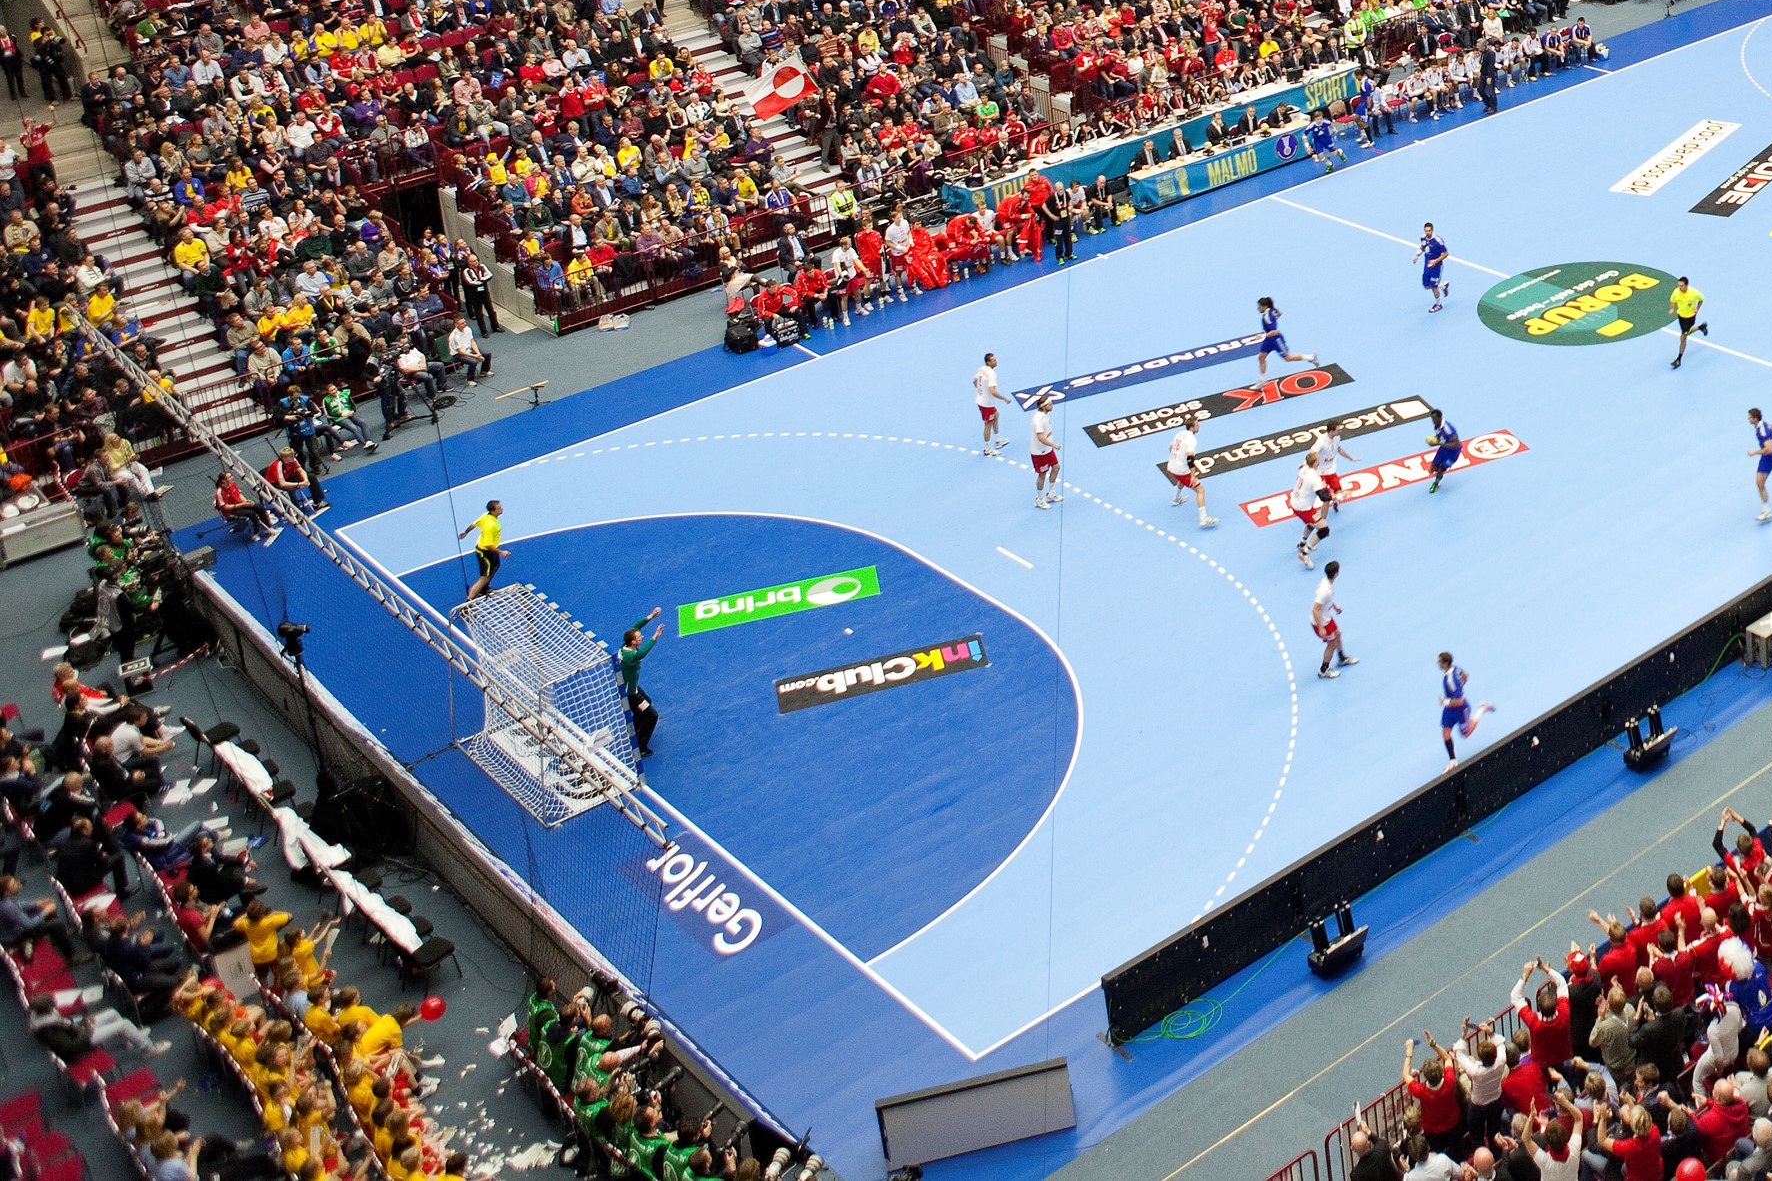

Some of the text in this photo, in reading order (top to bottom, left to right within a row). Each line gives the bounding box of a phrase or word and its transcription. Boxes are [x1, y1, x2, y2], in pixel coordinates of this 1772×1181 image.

[1304, 73, 1348, 110] SPORT
[1207, 147, 1258, 187] MALMÖ
[1524, 273, 1660, 336] BORUP
[1069, 332, 1267, 389] GRUNDFOS
[1223, 370, 1333, 412] OK
[1098, 400, 1203, 434] SPORTEN
[695, 585, 801, 621] bring
[779, 639, 981, 694] inkClub.com
[646, 841, 763, 954] Gerflor
